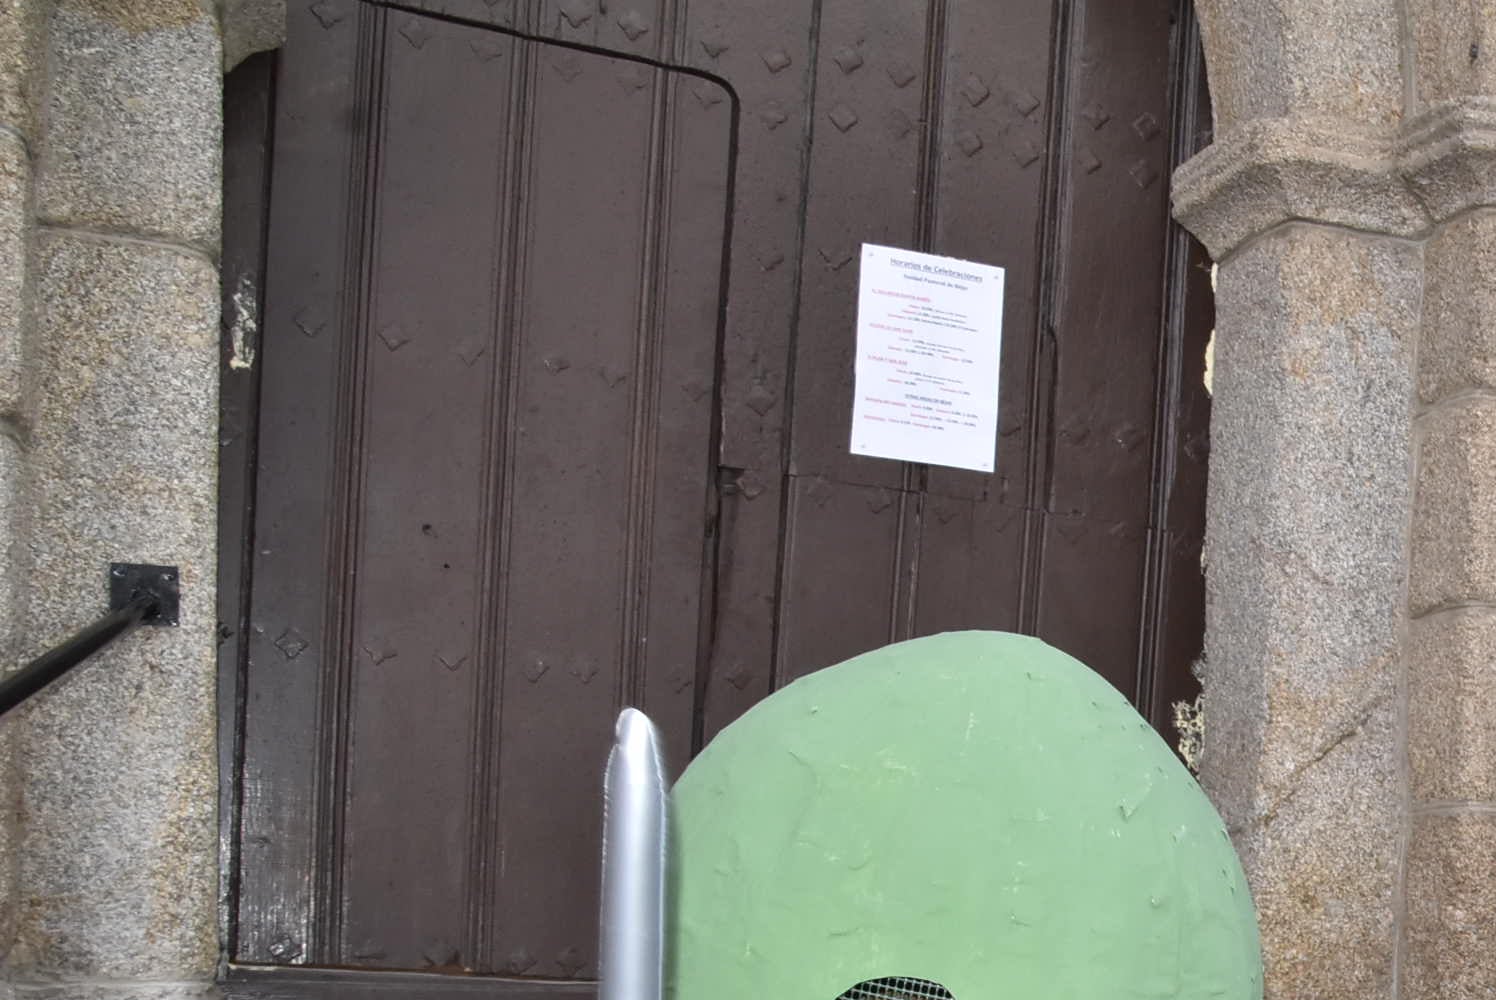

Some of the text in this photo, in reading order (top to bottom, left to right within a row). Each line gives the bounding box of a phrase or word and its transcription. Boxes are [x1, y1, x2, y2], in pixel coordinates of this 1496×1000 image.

[890, 257, 983, 283] Horarios de Celebraciones
